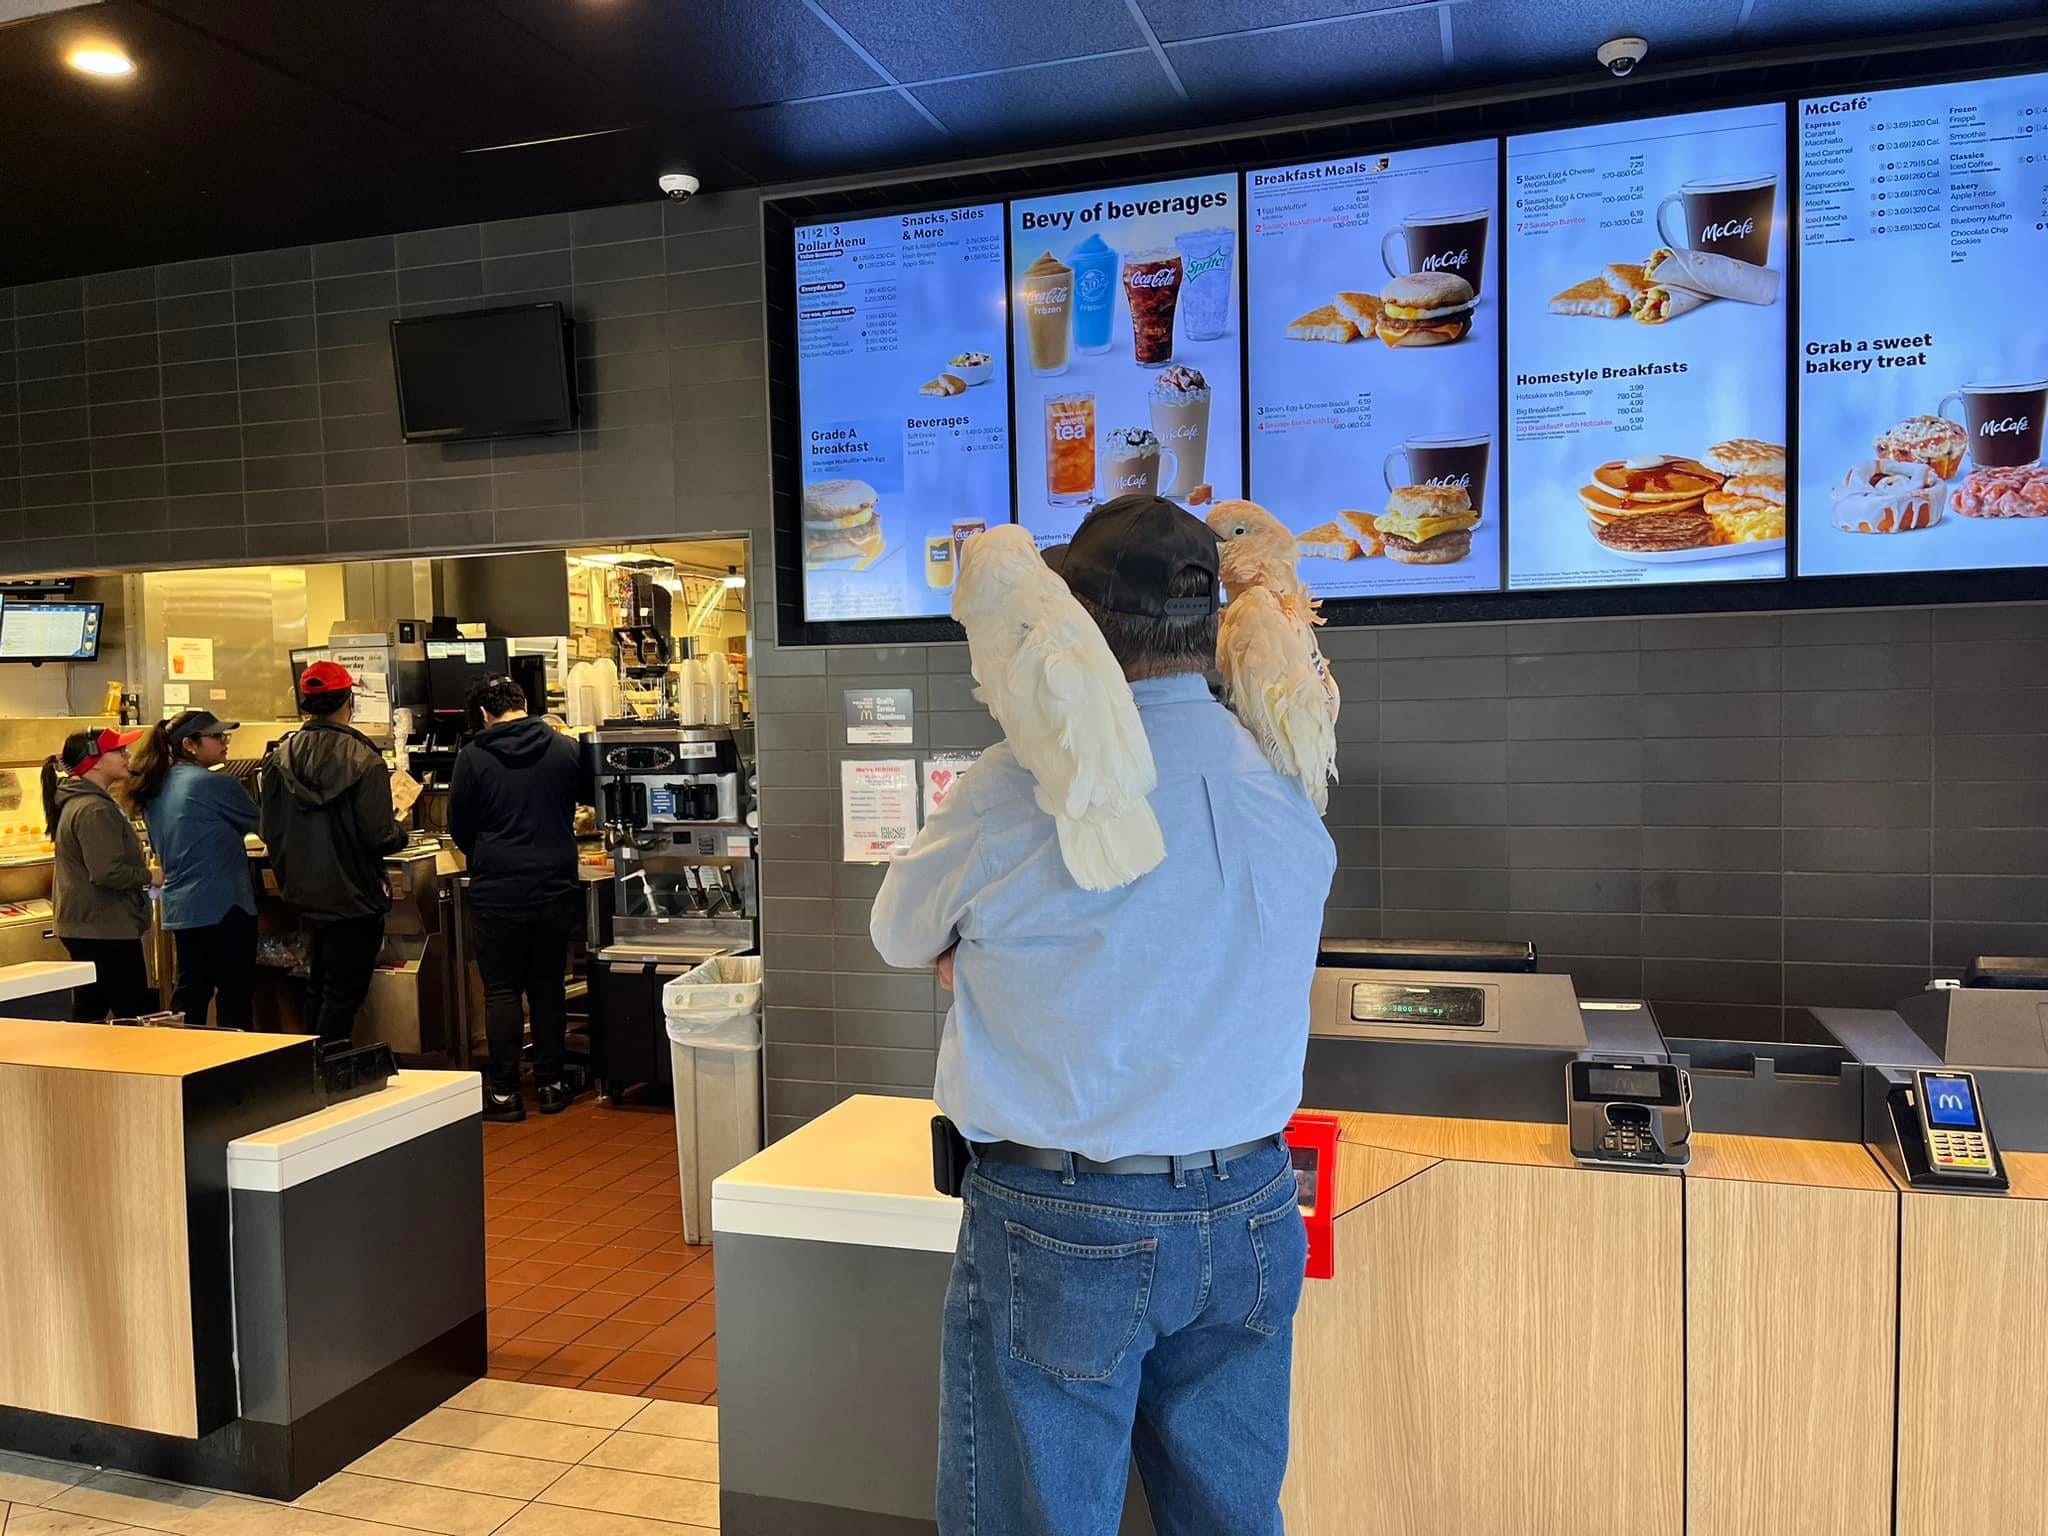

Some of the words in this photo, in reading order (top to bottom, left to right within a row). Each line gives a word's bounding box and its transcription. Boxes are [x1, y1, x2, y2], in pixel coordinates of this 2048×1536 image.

[1949, 106, 1977, 114] Frozen
[1805, 120, 1841, 130] Espresso
[1950, 131, 1986, 140] Smoothie
[1805, 137, 1843, 147] Macchiato
[1950, 152, 1984, 160] Classics
[1805, 157, 1843, 167] Macchiato
[1968, 160, 1993, 168] Coffee
[1255, 168, 1321, 185] Breakfast
[1325, 162, 1366, 177] Meals
[1805, 168, 1845, 178] Americano
[1516, 176, 1523, 184] 5
[1951, 192, 1972, 200] Apple
[1516, 200, 1523, 208] 6
[1805, 199, 1830, 207] Mocha
[1951, 204, 1989, 212] Cinnamon
[1022, 210, 1074, 230] Bevy
[1080, 203, 1102, 222] of
[1107, 192, 1227, 219] beverages
[902, 213, 948, 227] Snacks,
[951, 209, 984, 221] Sides
[1823, 214, 1847, 223] Mocha
[1951, 216, 1986, 224] Blueberry
[1988, 214, 2012, 222] Muffin
[1517, 224, 1524, 232] 7
[1701, 217, 1754, 243] McCafé
[903, 231, 910, 240] &
[914, 229, 944, 239] More
[1805, 232, 1824, 241] Latte
[798, 241, 832, 252] Dollar
[835, 237, 865, 248] Menu
[1951, 238, 1981, 246] Cookies
[1422, 249, 1469, 271] McCafé
[1188, 257, 1224, 274] Sprite
[1806, 339, 1851, 356] Grab
[1857, 340, 1868, 352] a
[1873, 333, 1932, 350] sweet
[1806, 356, 1872, 374] bakery
[1877, 352, 1927, 369] treat
[1516, 369, 1598, 386] Homestyle
[1602, 361, 1688, 379] Breakfasts
[1517, 392, 1547, 400] Hotcakes
[1258, 407, 1264, 415] 3
[1517, 408, 1527, 416] Big
[908, 416, 969, 428] Beverages
[1980, 416, 2030, 437] McCafé
[812, 429, 845, 440] Grade
[849, 428, 856, 438] A
[1055, 423, 1086, 440] tea
[812, 441, 869, 454] breakfast
